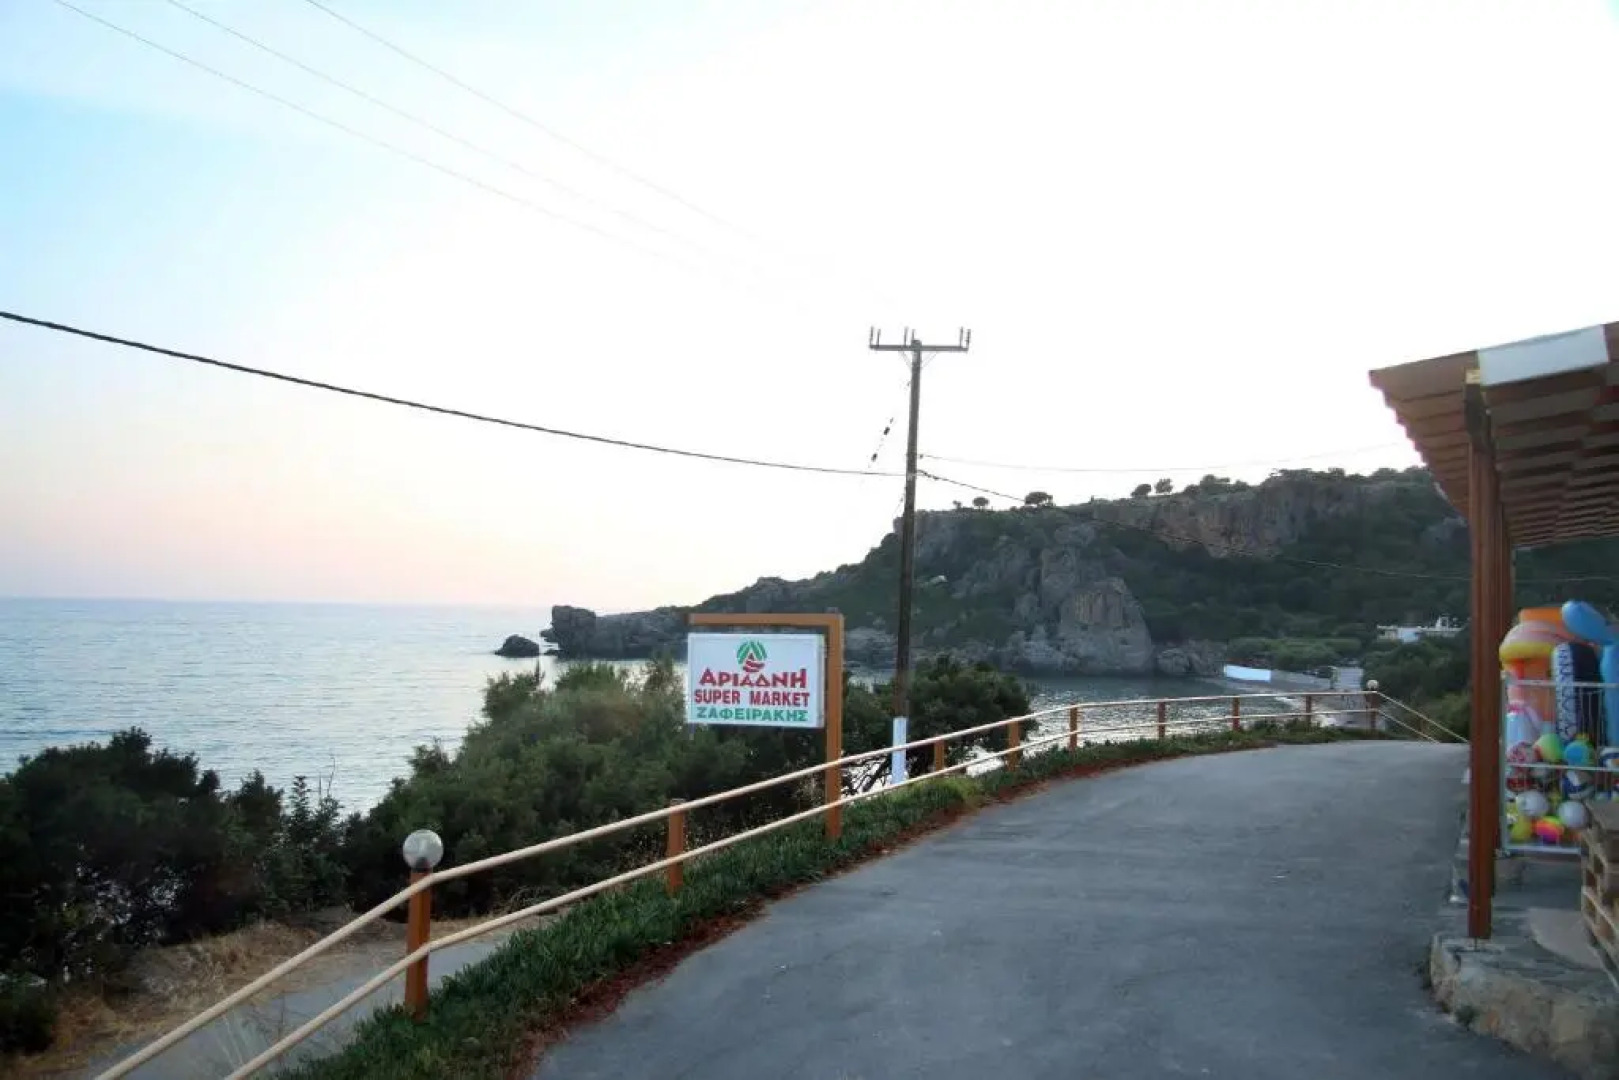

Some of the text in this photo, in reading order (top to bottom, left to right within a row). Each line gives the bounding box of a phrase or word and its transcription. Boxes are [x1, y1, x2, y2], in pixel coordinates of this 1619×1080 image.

[695, 689, 810, 707] SUPER MARKET
[697, 707, 808, 721] ΖΑΦΕΙΡΑΚΗΣ
